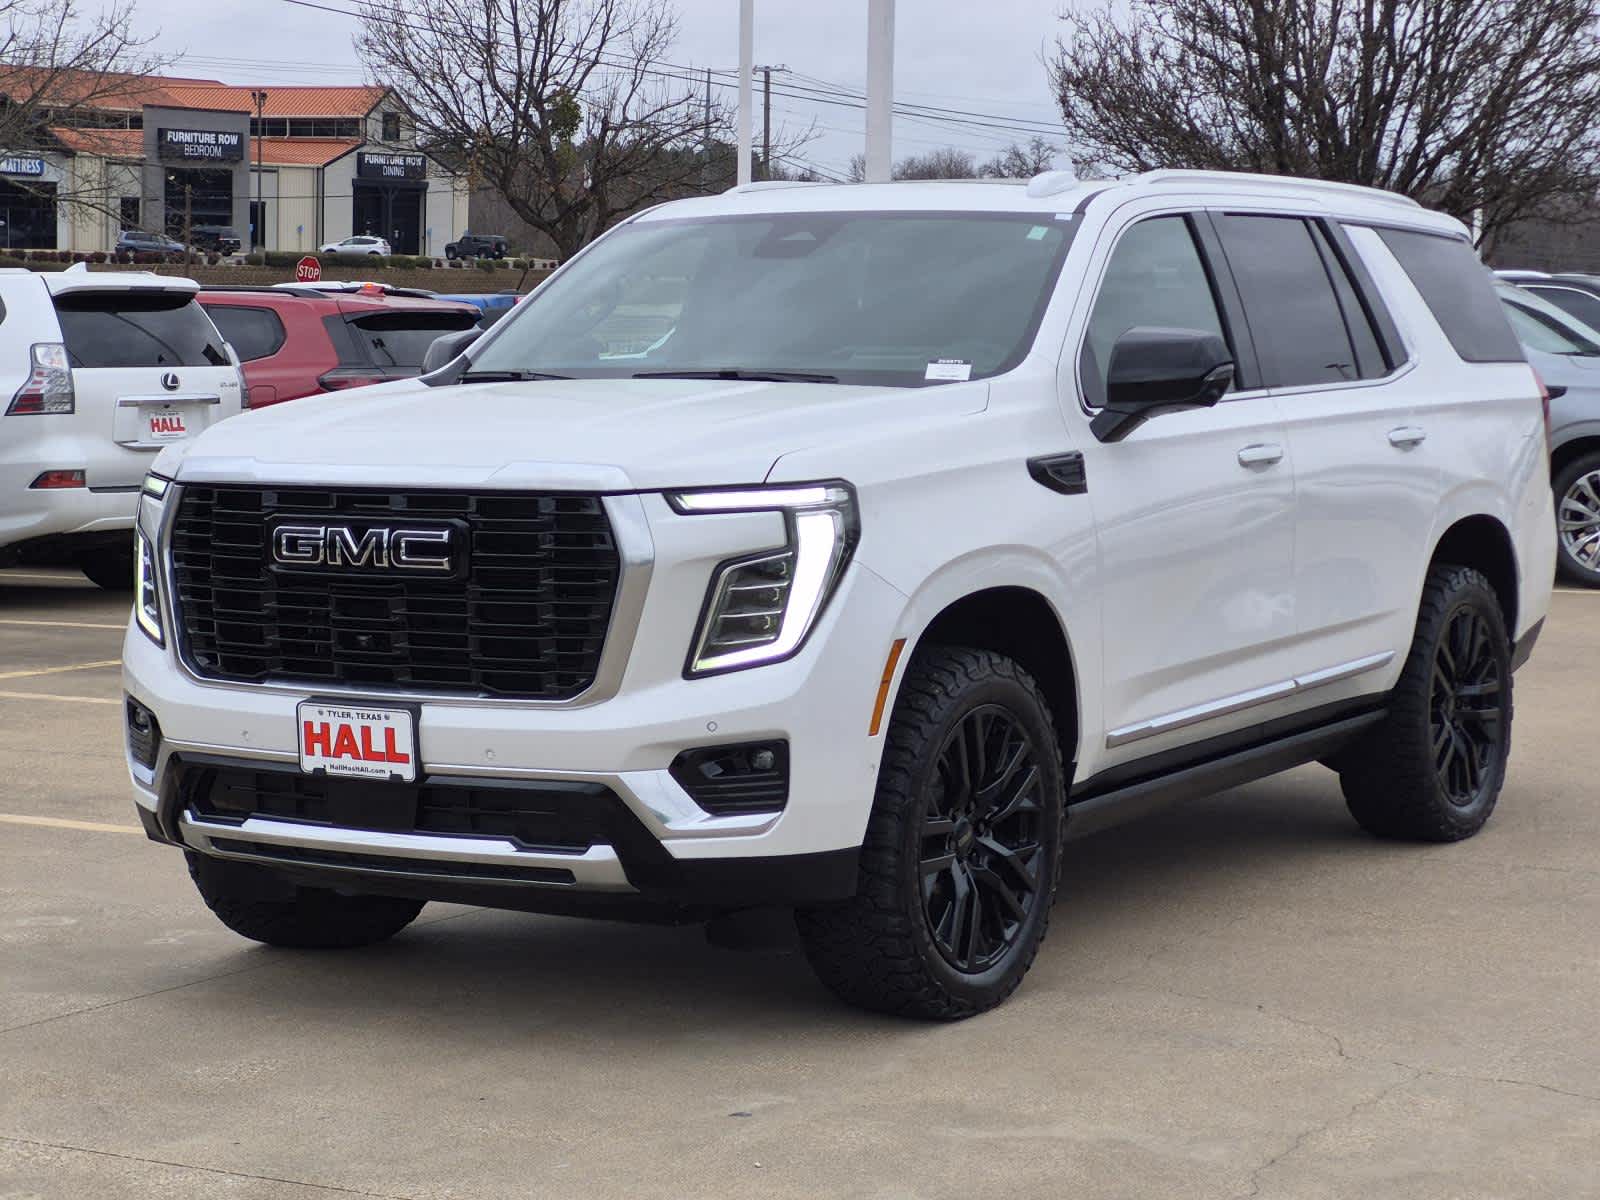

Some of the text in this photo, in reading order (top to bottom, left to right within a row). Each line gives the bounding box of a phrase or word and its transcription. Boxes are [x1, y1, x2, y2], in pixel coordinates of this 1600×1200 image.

[167, 131, 239, 145] FURNITURE ROW
[184, 144, 222, 157] BEDROOM
[364, 154, 423, 166] FURNITURE ROW
[382, 165, 405, 177] DINING
[298, 265, 320, 279] STOP
[150, 417, 186, 432] HALL
[273, 526, 450, 570] GMC
[327, 710, 382, 720] TYLER, TEXAS
[304, 720, 410, 764] HALL
